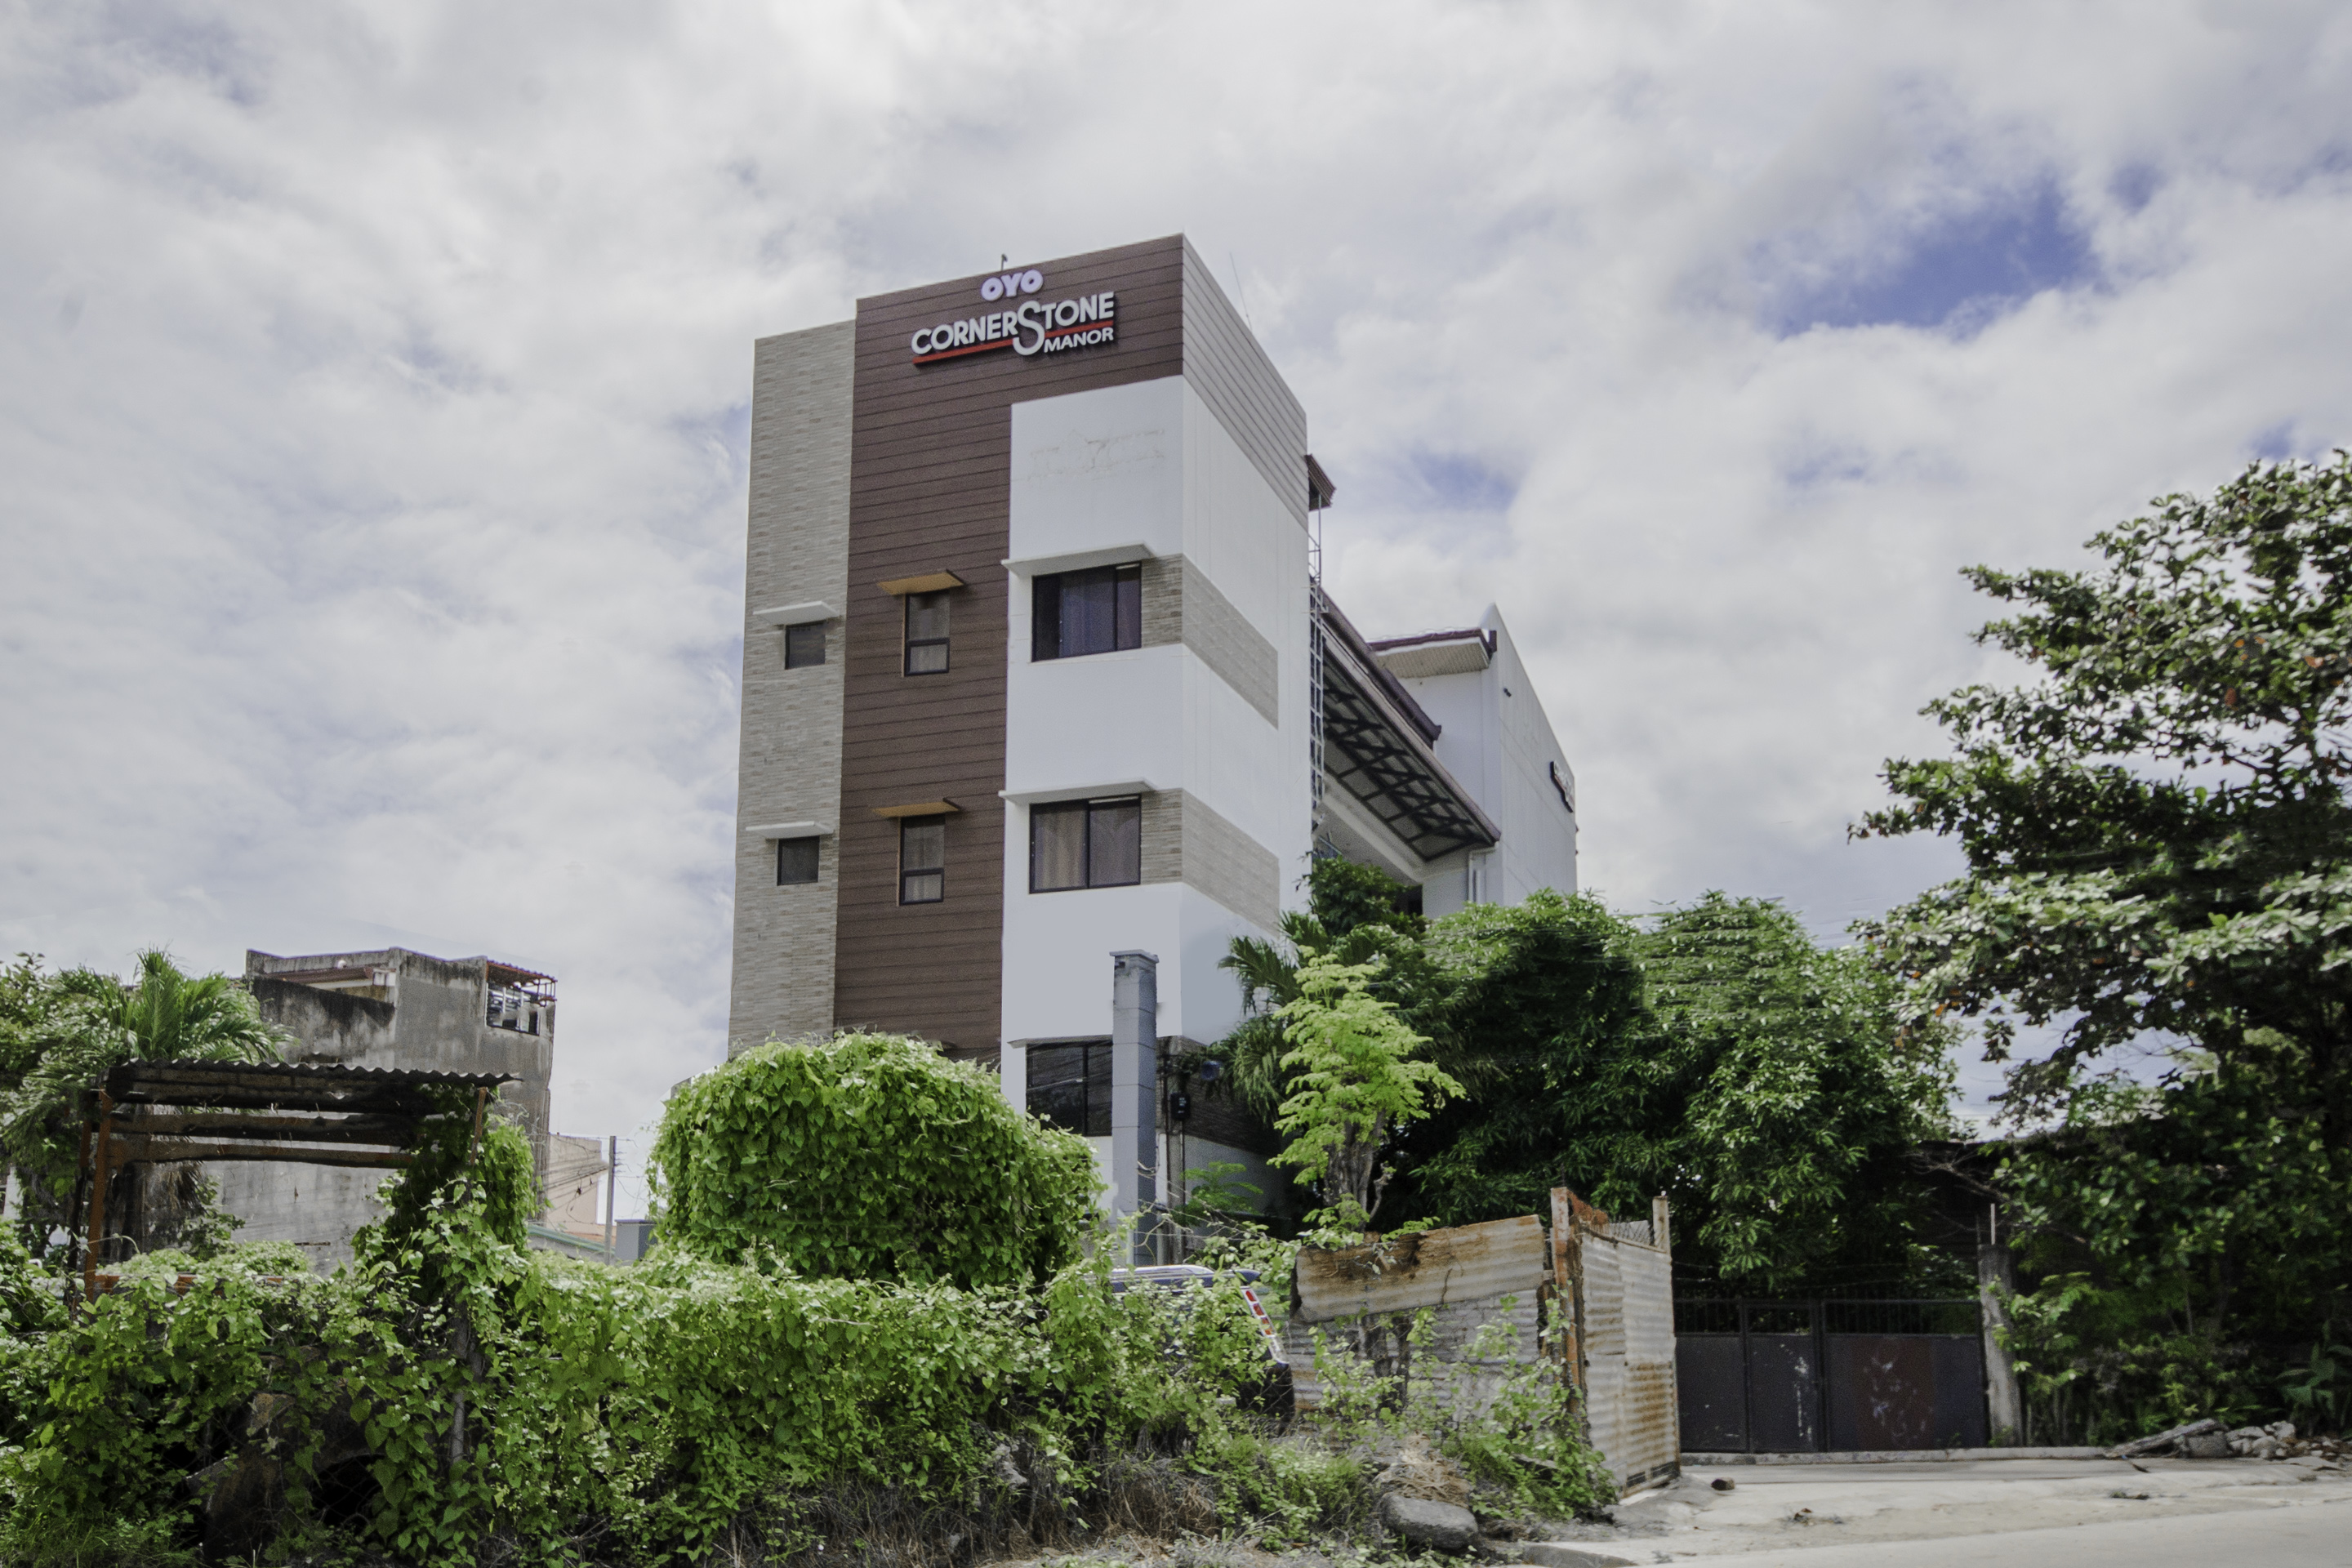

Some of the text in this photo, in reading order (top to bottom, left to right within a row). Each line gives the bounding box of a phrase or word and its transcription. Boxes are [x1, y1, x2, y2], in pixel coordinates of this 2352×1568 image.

[981, 269, 1044, 301] OYO
[911, 292, 1115, 356] CORNERSTONE
[1043, 327, 1114, 353] MANOR
